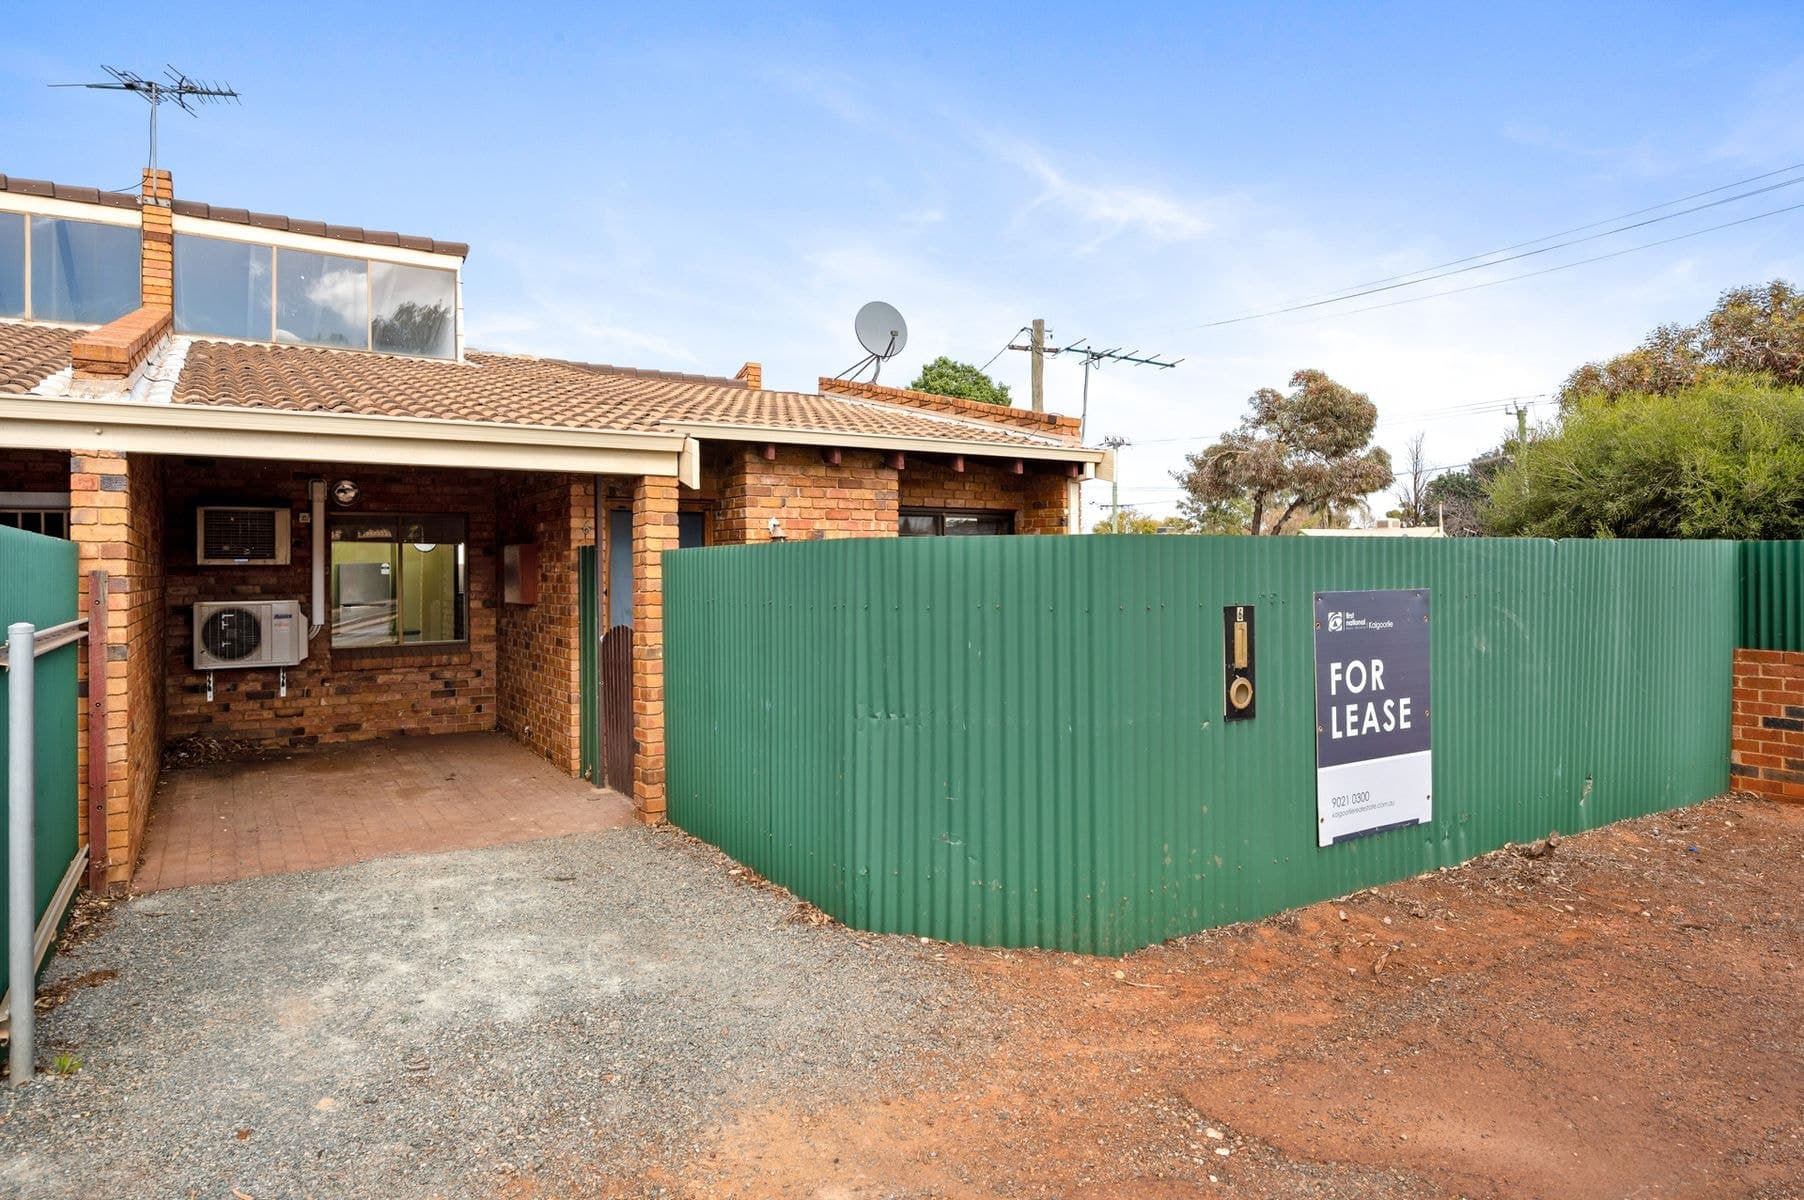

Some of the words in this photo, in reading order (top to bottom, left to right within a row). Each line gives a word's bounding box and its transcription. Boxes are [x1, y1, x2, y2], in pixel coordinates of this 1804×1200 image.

[1346, 618, 1366, 626] national
[1330, 659, 1385, 696] FOR
[1331, 697, 1411, 739] LEASE
[1331, 795, 1350, 808] 9021
[1352, 791, 1370, 804] 0300
